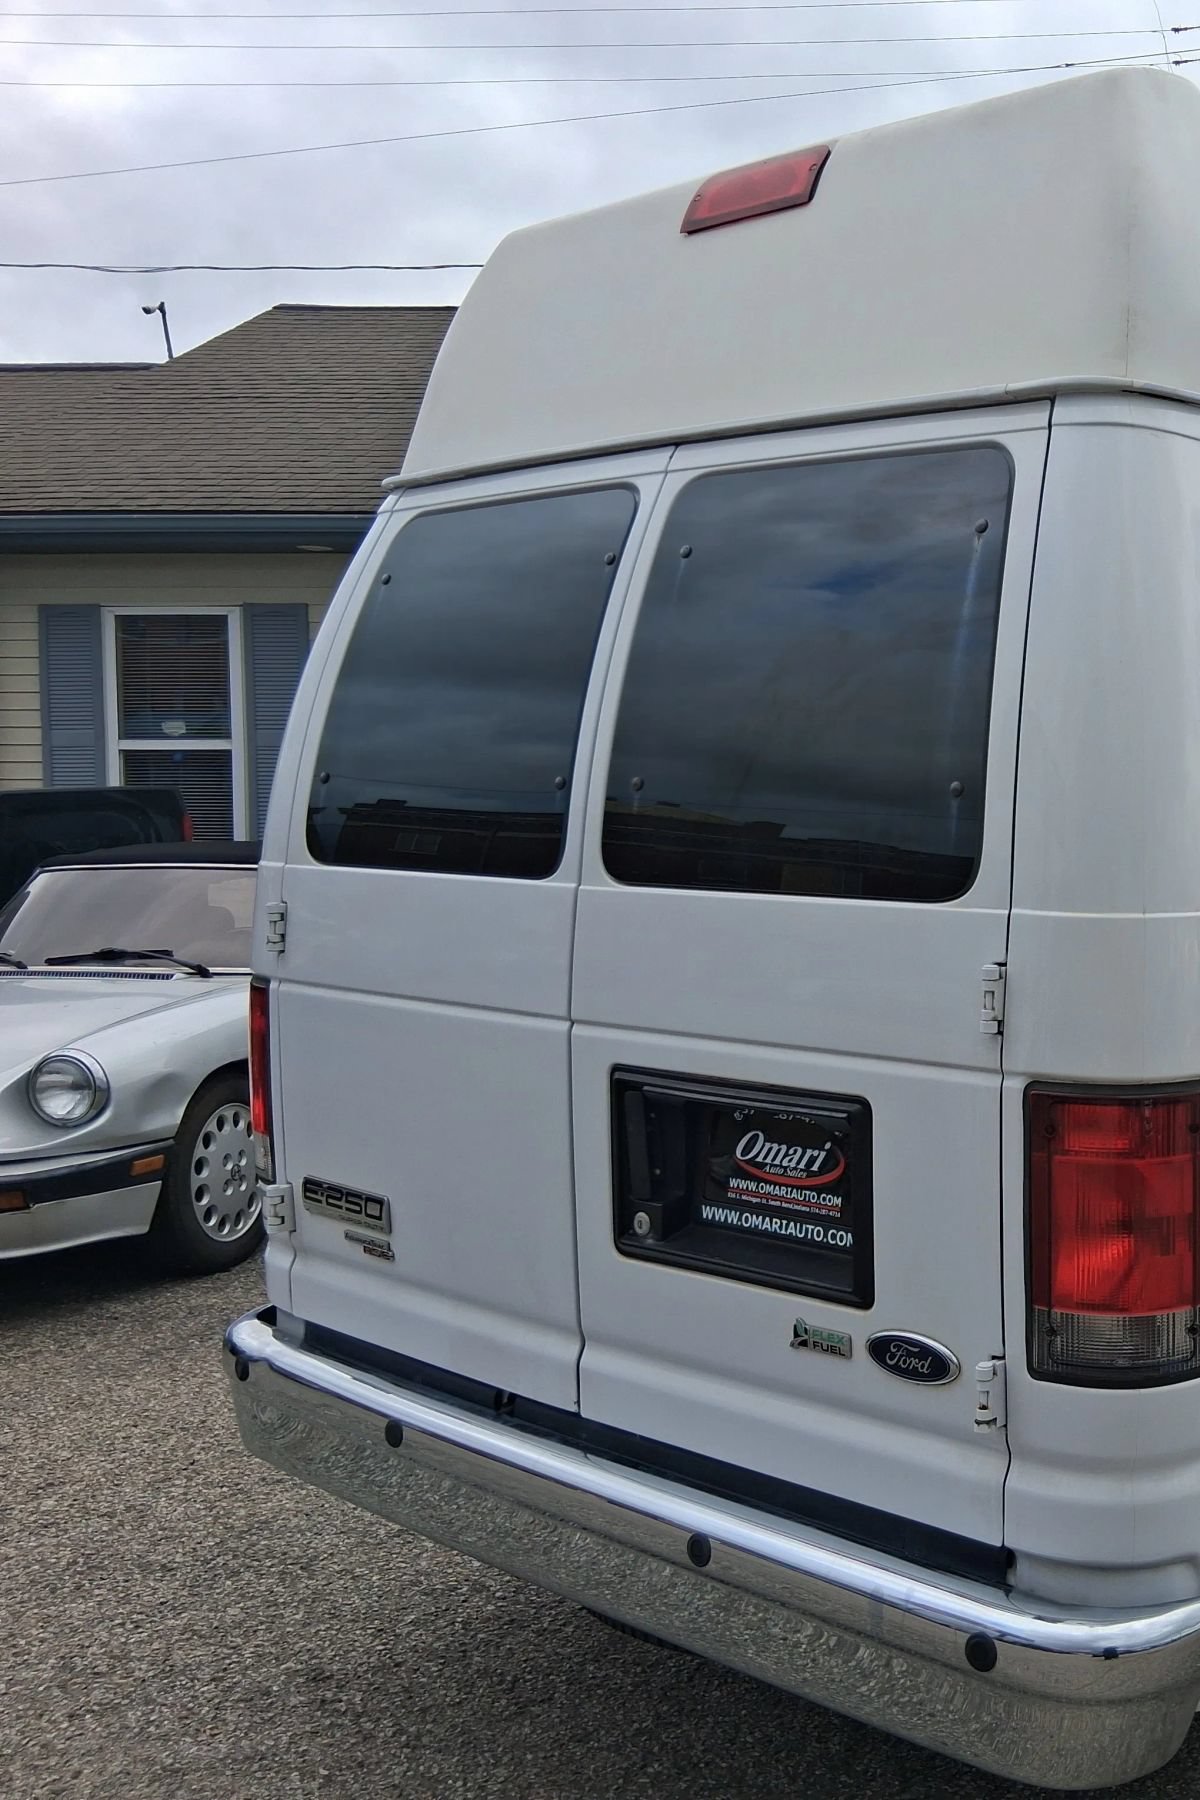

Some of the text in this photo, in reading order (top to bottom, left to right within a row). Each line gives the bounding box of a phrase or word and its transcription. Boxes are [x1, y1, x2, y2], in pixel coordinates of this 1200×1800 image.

[735, 1131, 832, 1172] Omari
[762, 1164, 807, 1179] Auto Sales
[729, 1177, 842, 1208] WWW.OMARIAUTO.COM
[811, 1329, 846, 1345] FLEX
[812, 1341, 846, 1357] FUEL
[886, 1341, 932, 1374] Ford
